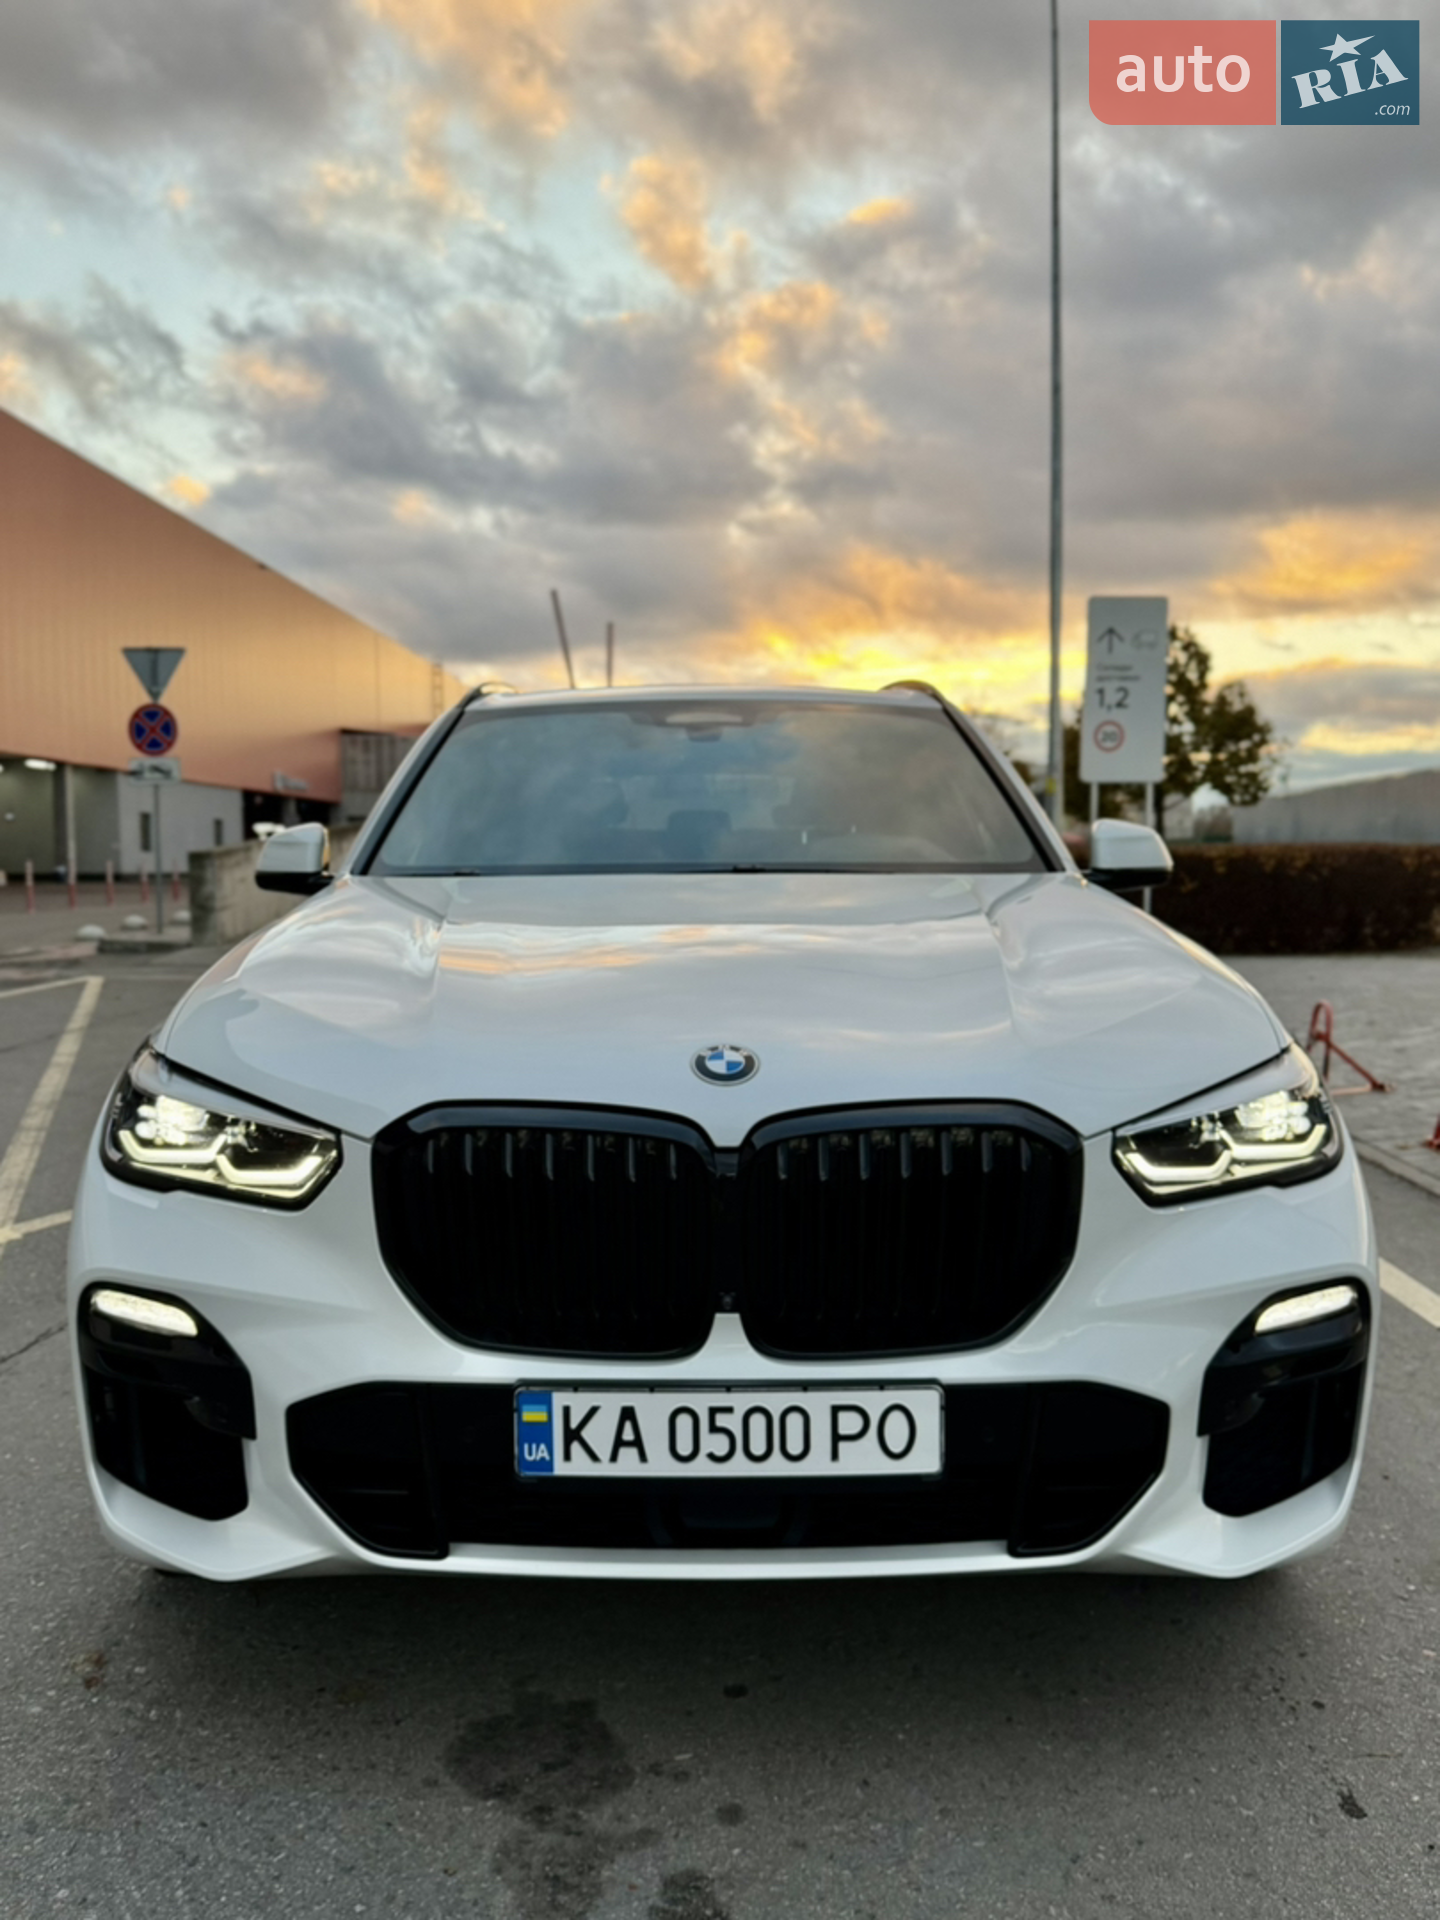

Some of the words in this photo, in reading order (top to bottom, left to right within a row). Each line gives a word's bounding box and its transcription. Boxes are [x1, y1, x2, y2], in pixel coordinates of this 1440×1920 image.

[1095, 686, 1130, 712] 1,2
[562, 1405, 649, 1463] KA
[668, 1405, 811, 1463] 0500
[830, 1403, 917, 1463] PO
[523, 1443, 550, 1461] UA
